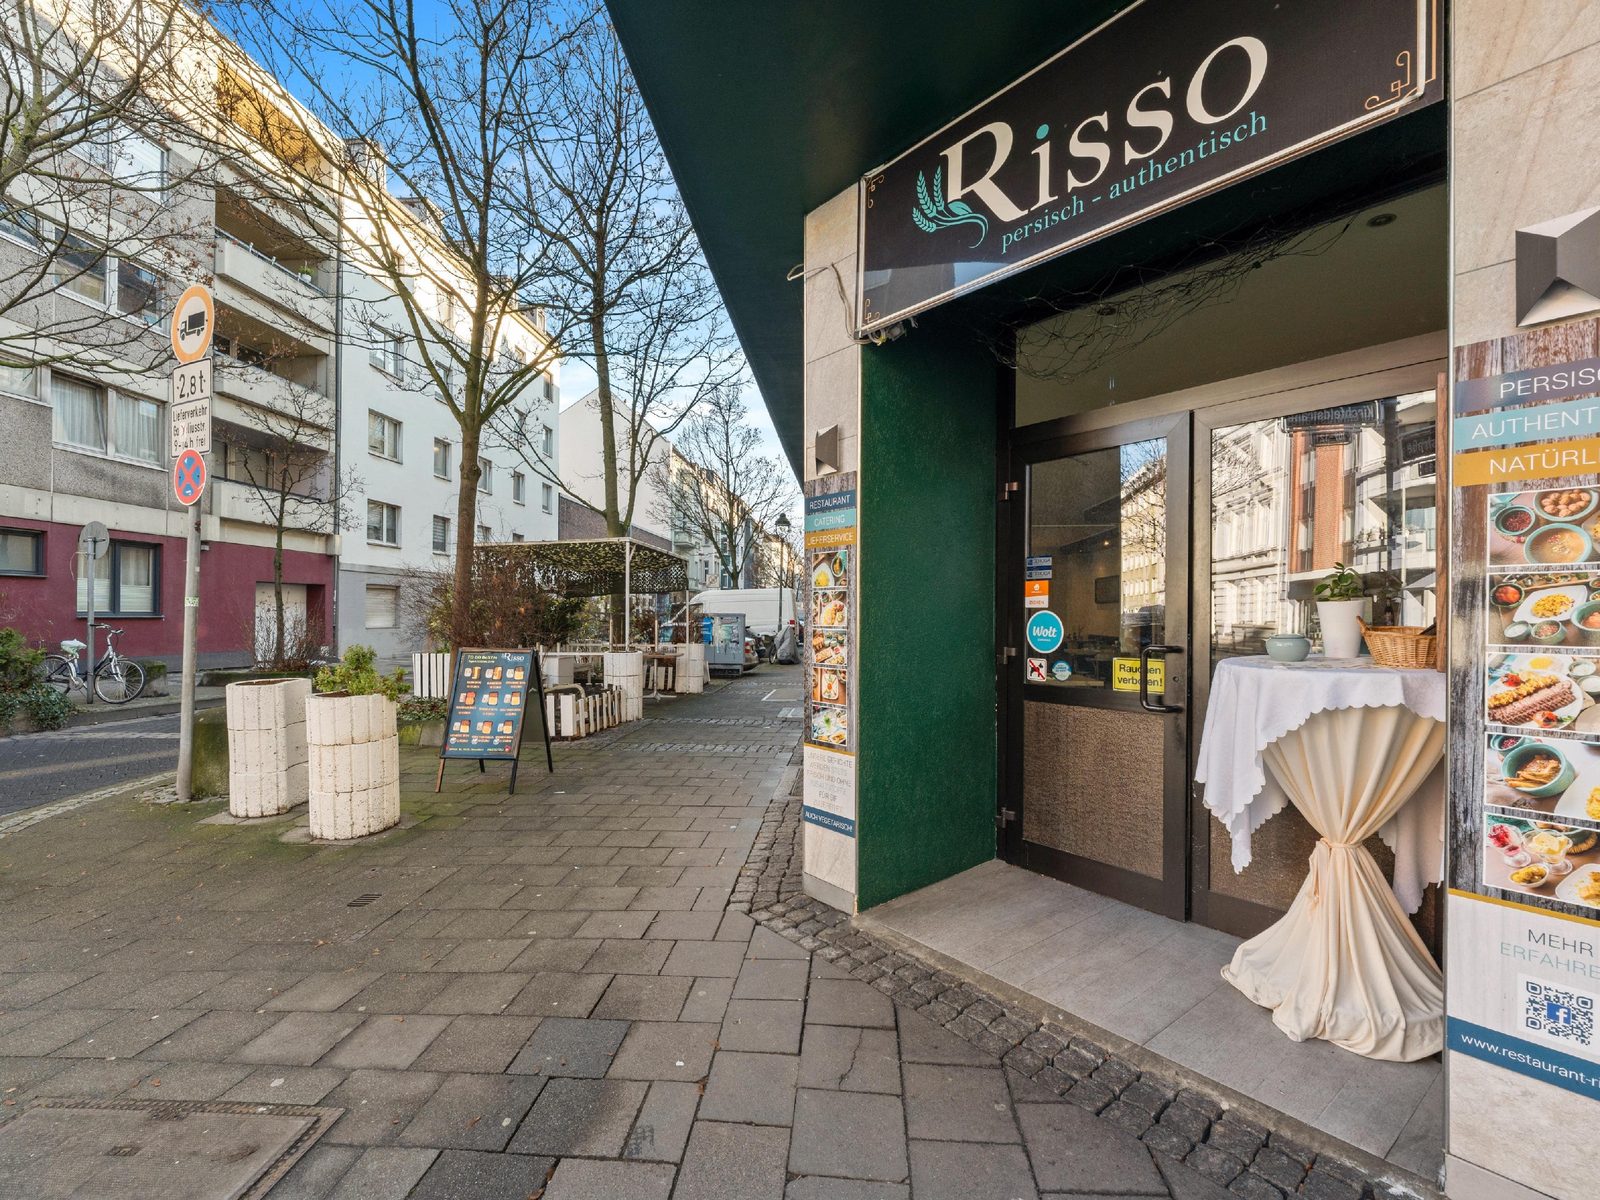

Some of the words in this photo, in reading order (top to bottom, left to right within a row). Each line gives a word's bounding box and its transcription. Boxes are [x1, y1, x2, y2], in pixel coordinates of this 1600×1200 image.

[1001, 196, 1085, 255] persisch
[1109, 110, 1268, 200] authentisch
[179, 373, 197, 399] 2,8
[199, 369, 204, 394] t
[1500, 367, 1600, 399] PERSIS
[173, 404, 207, 422] Lieferverkehr
[1472, 406, 1599, 440] AUTHENT
[196, 434, 205, 447] frei
[810, 495, 850, 509] RESTAURANT
[814, 515, 845, 527] CATERING
[1032, 625, 1057, 638] Wolt
[1119, 663, 1161, 675] Raucen
[1117, 676, 1163, 687] verboen!
[1528, 928, 1594, 957] MEHR
